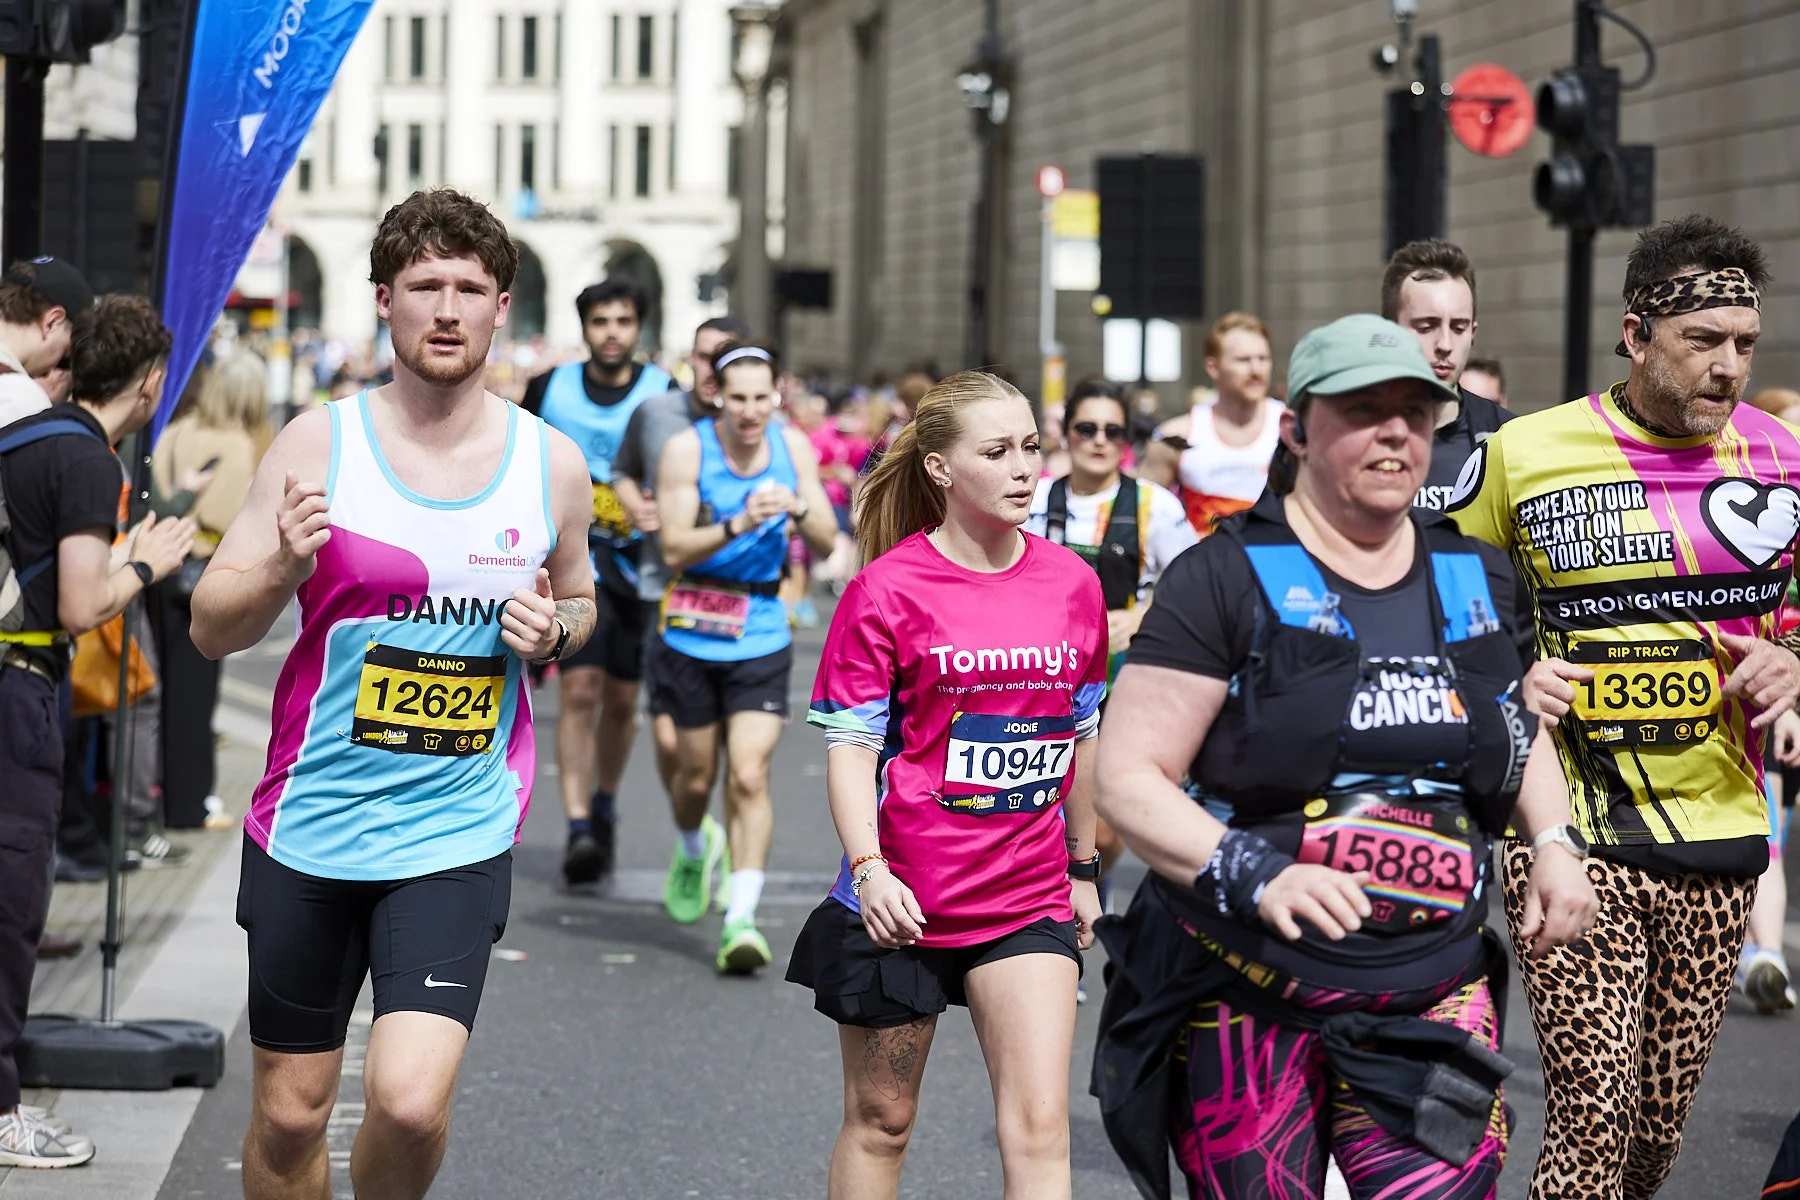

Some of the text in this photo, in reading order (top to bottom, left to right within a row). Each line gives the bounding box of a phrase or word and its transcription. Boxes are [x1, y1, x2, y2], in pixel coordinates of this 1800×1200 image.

[1520, 482, 1647, 525] #WEAR YOUR
[1529, 511, 1621, 548] HEART ON
[1546, 534, 1673, 571] YOUR SLEEVE
[1559, 581, 1781, 618] STRONGMEN.ORG.UK
[417, 657, 466, 672] DANNO
[929, 640, 1078, 676] Tommy's
[1608, 645, 1680, 658] RIP TRACY
[371, 677, 492, 720] 12624
[936, 685, 955, 694] The
[956, 682, 1003, 695] pregnancy
[1006, 680, 1025, 690] and
[1027, 680, 1052, 691] baby
[1579, 671, 1711, 709] 13369
[1003, 721, 1038, 734] JODIE
[960, 743, 1069, 780] 10947
[1320, 830, 1462, 891] 15883
